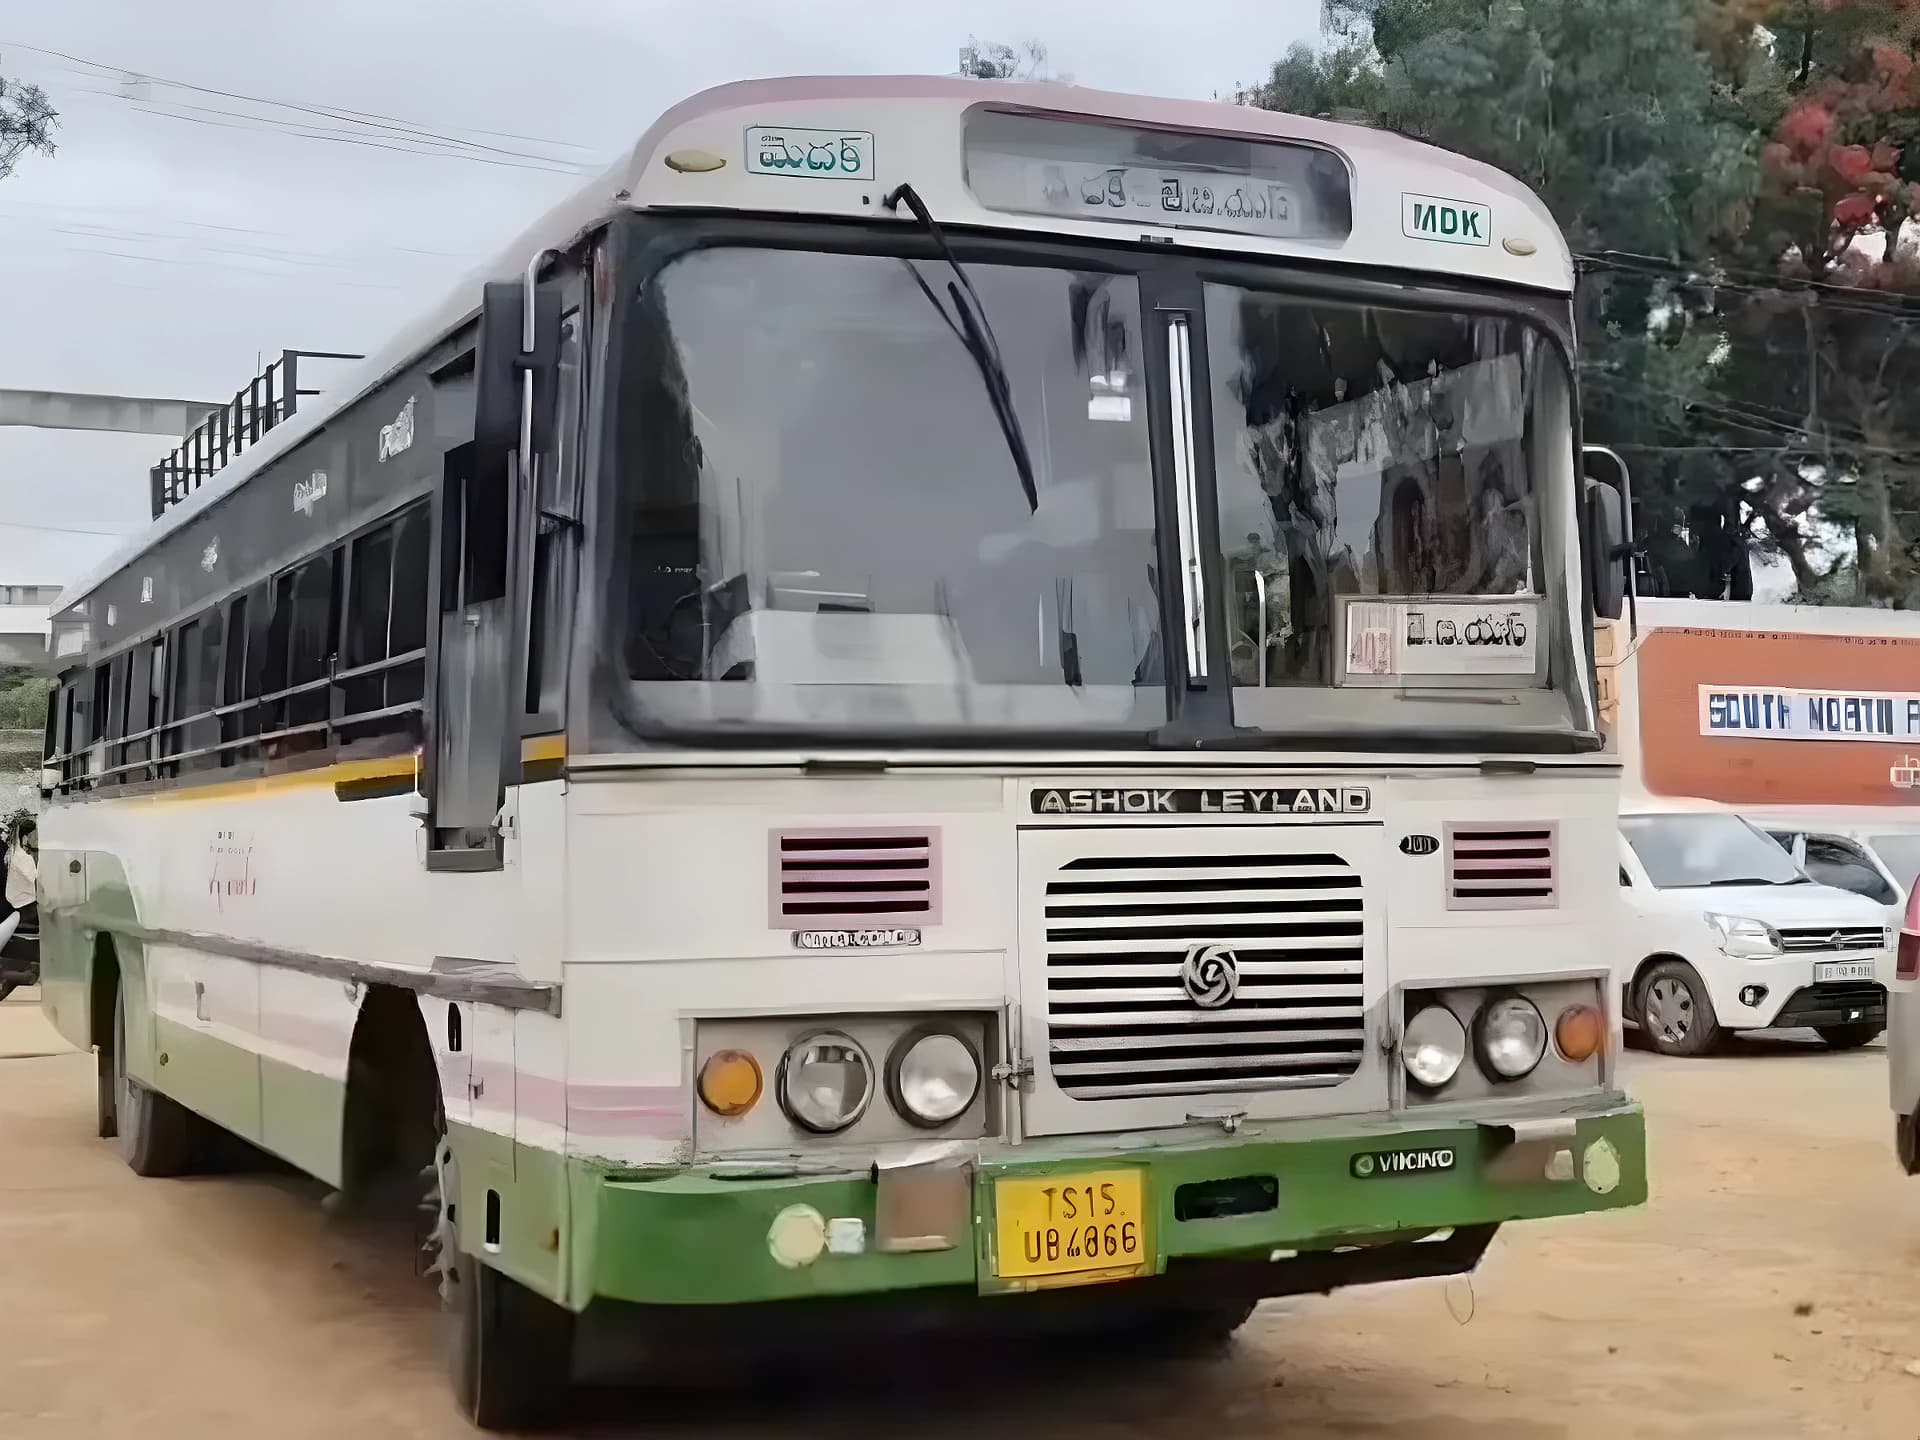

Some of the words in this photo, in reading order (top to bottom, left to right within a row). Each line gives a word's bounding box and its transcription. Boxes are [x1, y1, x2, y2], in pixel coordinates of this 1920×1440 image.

[1413, 203, 1482, 238] MDK
[1040, 789, 1177, 813] ASHOK
[1200, 787, 1370, 813] LEYLAND
